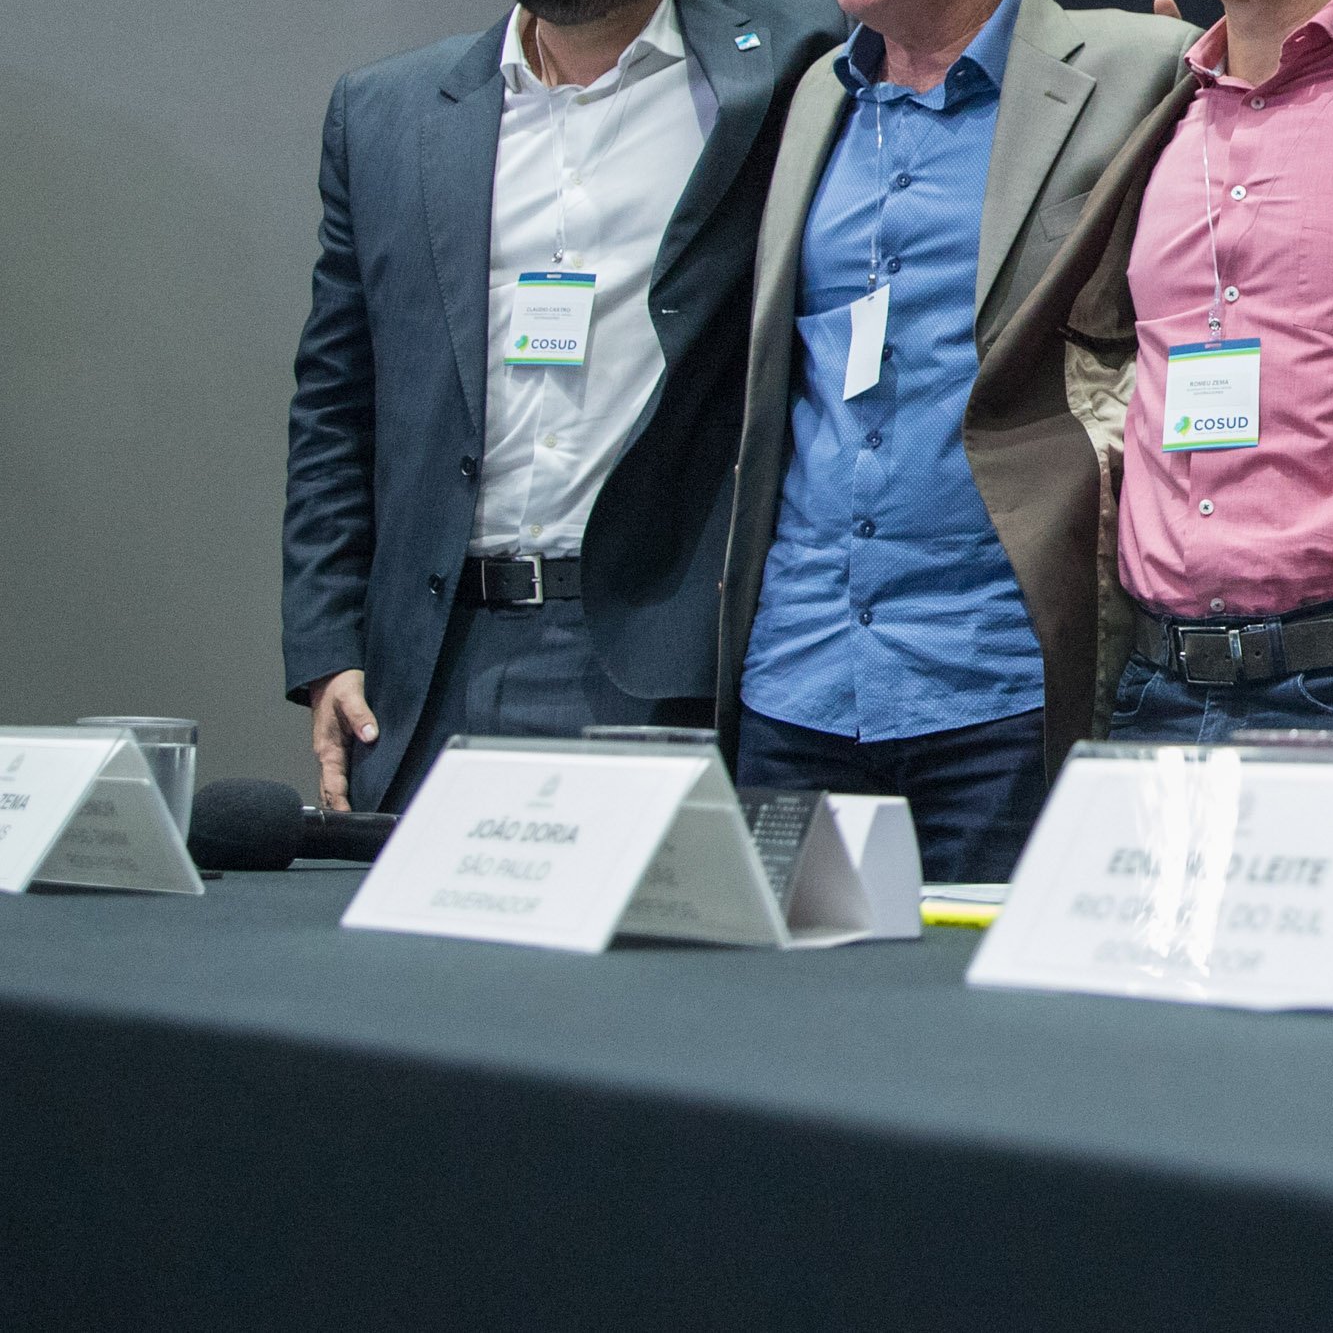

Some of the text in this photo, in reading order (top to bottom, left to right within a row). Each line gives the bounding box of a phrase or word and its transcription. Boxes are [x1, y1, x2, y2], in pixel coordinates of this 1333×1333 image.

[531, 338, 577, 350] COSUD
[1194, 416, 1249, 431] COSUD
[467, 815, 580, 845] JOÃO DORIA
[456, 852, 552, 881] SÃO PAULO
[1245, 854, 1331, 886] LEITE
